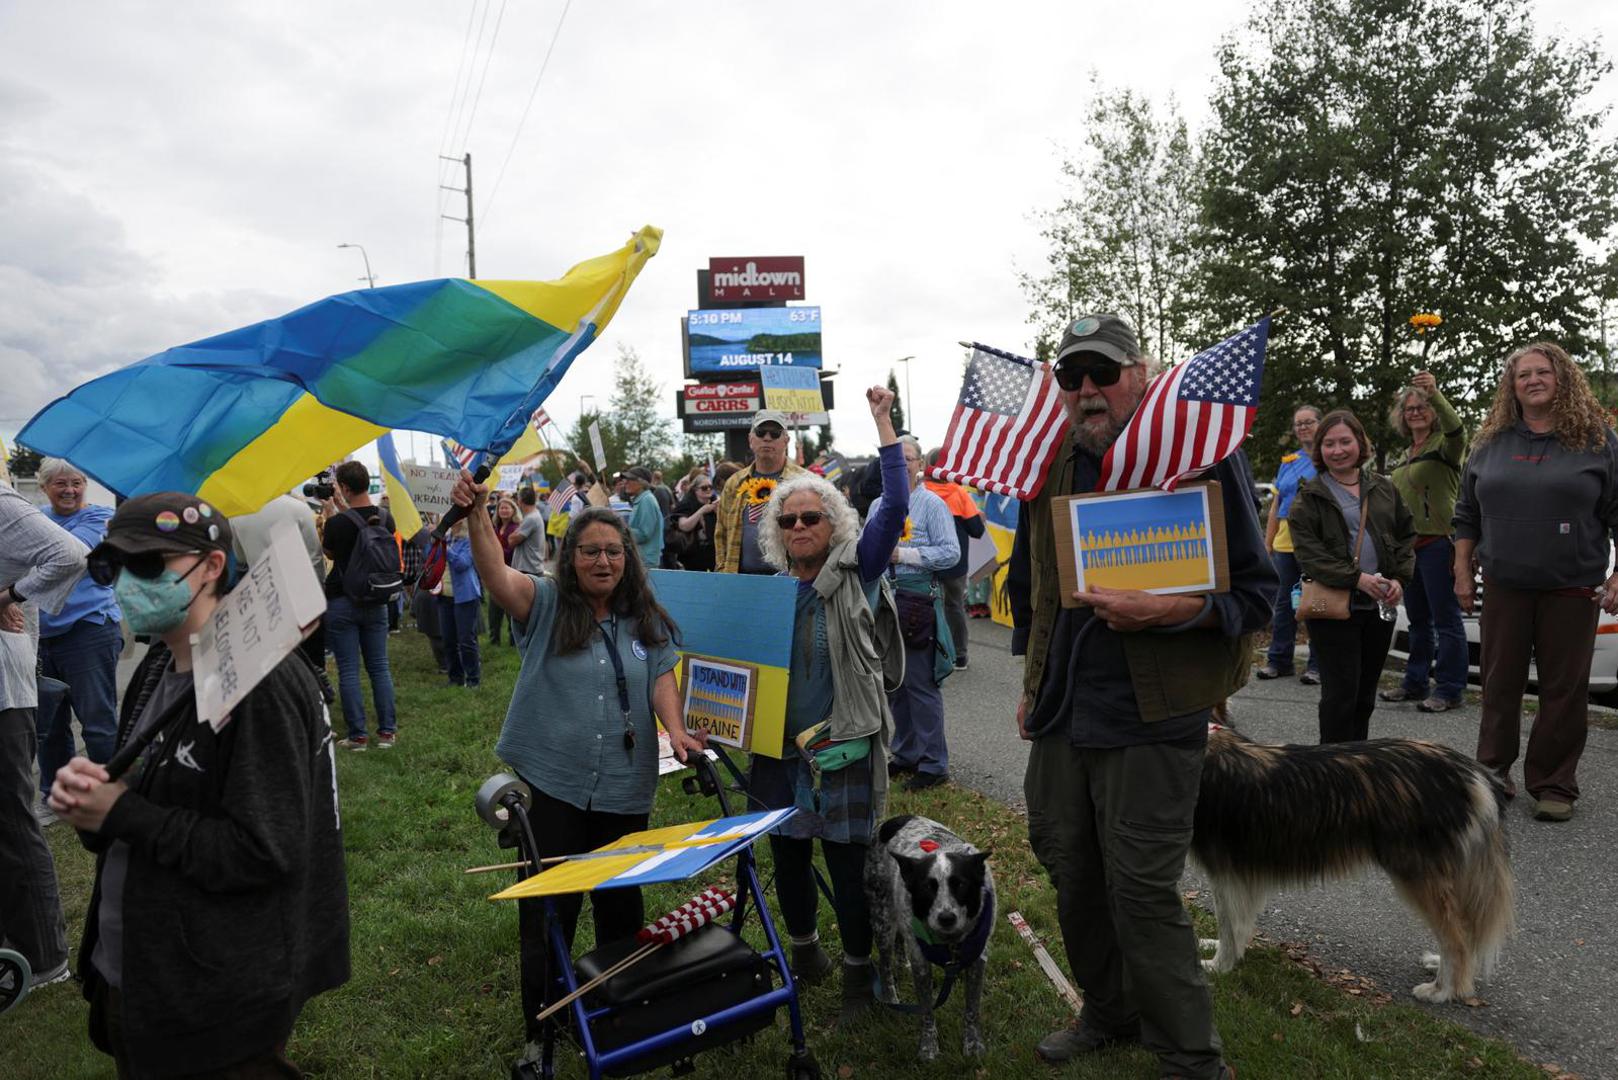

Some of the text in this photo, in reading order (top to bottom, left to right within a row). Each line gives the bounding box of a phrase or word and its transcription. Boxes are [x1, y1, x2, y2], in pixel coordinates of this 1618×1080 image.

[714, 262, 801, 287] midtown
[714, 286, 801, 296] MALL
[689, 314, 718, 325] 5:10
[720, 312, 742, 324] PM
[719, 352, 794, 367] AUGUST 14
[695, 399, 750, 412] CARRS
[410, 469, 426, 479] NO
[700, 667, 730, 689] STAND
[686, 713, 740, 740] UKRAINE
